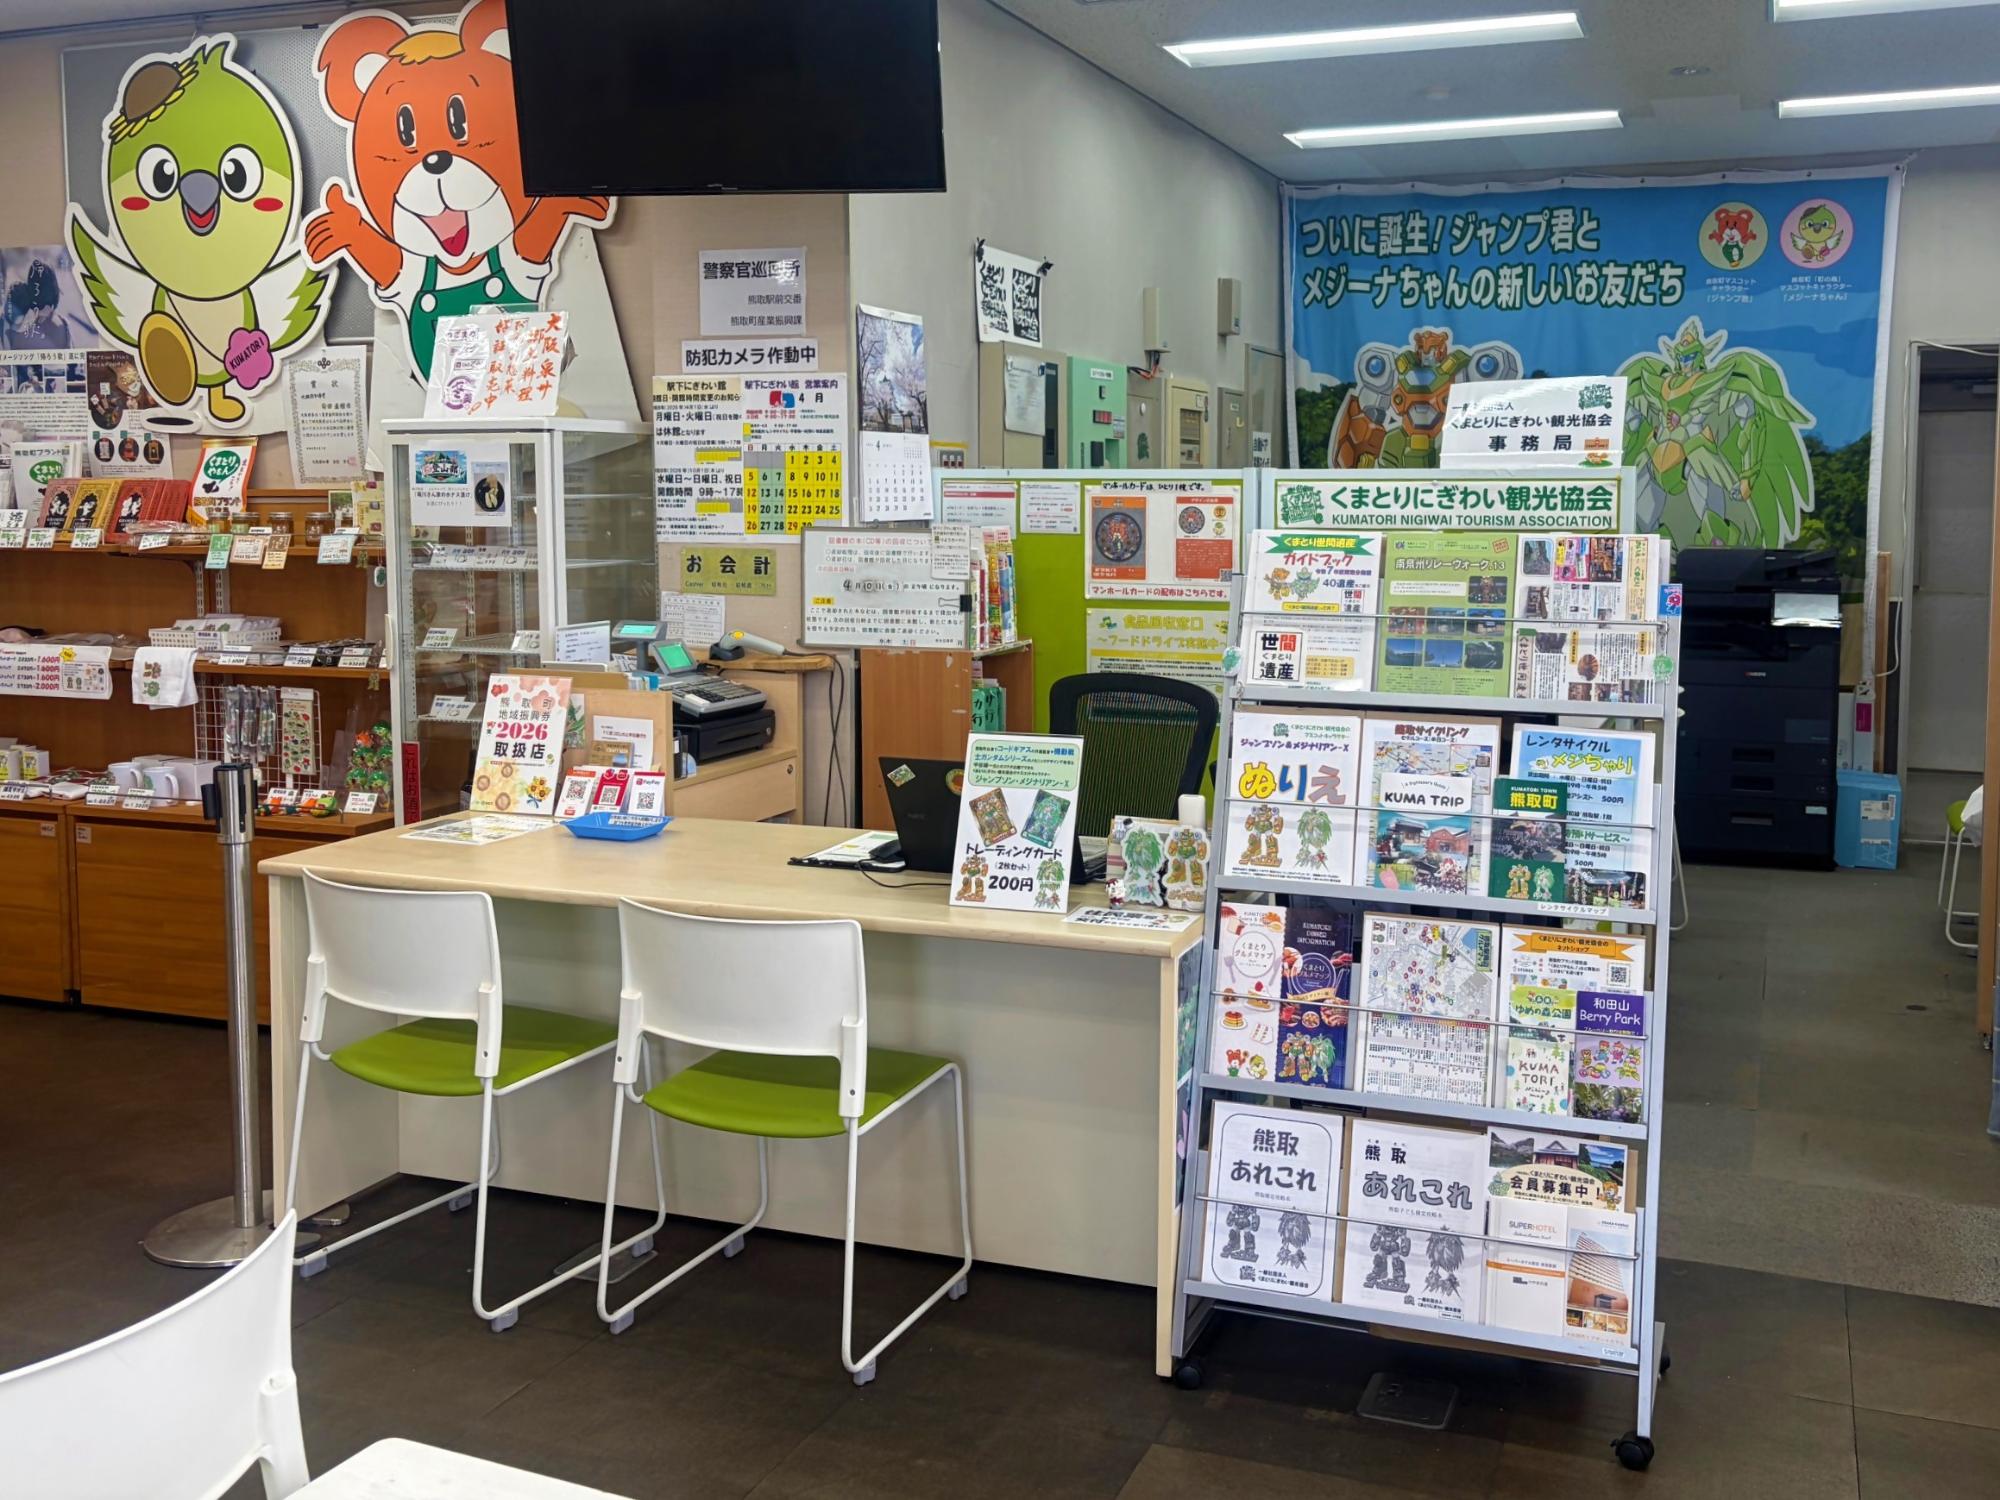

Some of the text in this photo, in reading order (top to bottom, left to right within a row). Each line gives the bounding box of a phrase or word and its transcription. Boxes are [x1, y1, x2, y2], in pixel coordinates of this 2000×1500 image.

[1302, 261, 1686, 308] メジーナちゃんの新しいお友だち
[229, 337, 265, 370] KUMATORI
[686, 346, 816, 367] 防犯カメラ作動中
[667, 381, 726, 391] 駅下にぎわい館
[799, 392, 823, 403] 4 月
[1451, 414, 1612, 430] くまとりにぎわい観光協会
[1488, 435, 1572, 452] 事務局
[790, 456, 837, 465] 1 2 3 4
[749, 472, 839, 481] 5 6 7 8 9 10 11
[746, 488, 840, 498] 12 13 14 15 16 17 18
[1330, 486, 1612, 512] くまとりにぎわい観光協会
[746, 504, 840, 514] 19 20 21 22 23 24 25
[746, 520, 757, 530] 26
[760, 520, 771, 530] 27
[774, 520, 784, 530] 28
[788, 520, 798, 530] 29
[1332, 515, 1612, 527] KUMATORI NIGIWAI TOURISM ASSOCIATION
[686, 555, 771, 575] お会計
[1283, 552, 1354, 566] ガイドブック
[1092, 586, 1228, 598] マンホールカードの配布はこちらです。
[1261, 633, 1297, 652] 世間
[1259, 662, 1294, 680] 遺産
[495, 721, 548, 740] 2026
[494, 742, 546, 759] 取扱店
[1526, 734, 1611, 752] レンタサイクル
[1551, 753, 1633, 774] メジちゃり
[1239, 761, 1347, 805] ぬりえ
[1385, 791, 1464, 807] KUMA TRIP
[1510, 792, 1559, 809] 熊取町
[1601, 795, 1624, 804] 500円
[965, 843, 1063, 860] トレーディングカード
[988, 875, 1034, 892] 200円
[1540, 903, 1608, 914] レンタサイクルマップ
[1242, 942, 1267, 950] くまとり
[1593, 998, 1630, 1011] 和田山
[1580, 1010, 1641, 1026] Berry Park
[1518, 1060, 1559, 1074] KUMA
[1253, 1128, 1300, 1156] 熊取
[1365, 1144, 1407, 1164] 熊取
[1230, 1160, 1317, 1192] あれこれ
[1362, 1171, 1473, 1210] あれこれ
